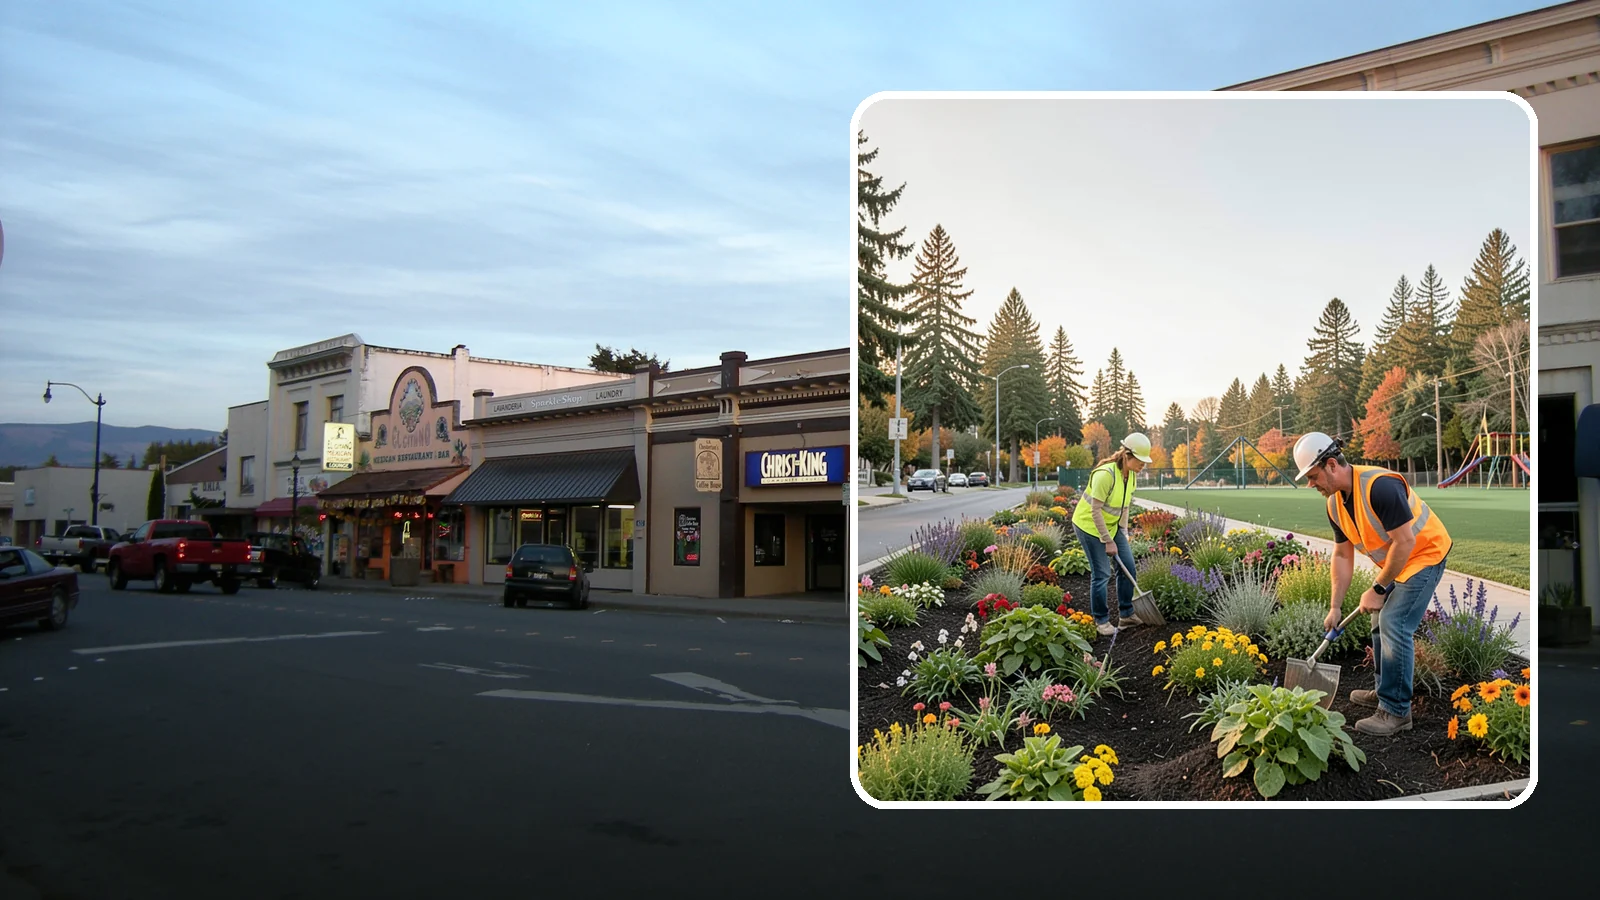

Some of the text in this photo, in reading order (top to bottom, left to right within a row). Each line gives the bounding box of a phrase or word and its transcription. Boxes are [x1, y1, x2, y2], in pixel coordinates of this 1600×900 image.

[530, 394, 582, 409] Sparkle Shop
[595, 389, 624, 400] LAUNDRY
[494, 402, 523, 413] LAVANDERIA
[373, 455, 396, 464] MEXICAN
[397, 451, 433, 462] RESTAURANT
[437, 450, 450, 459] BAR
[761, 450, 827, 478] CHRIST KING
